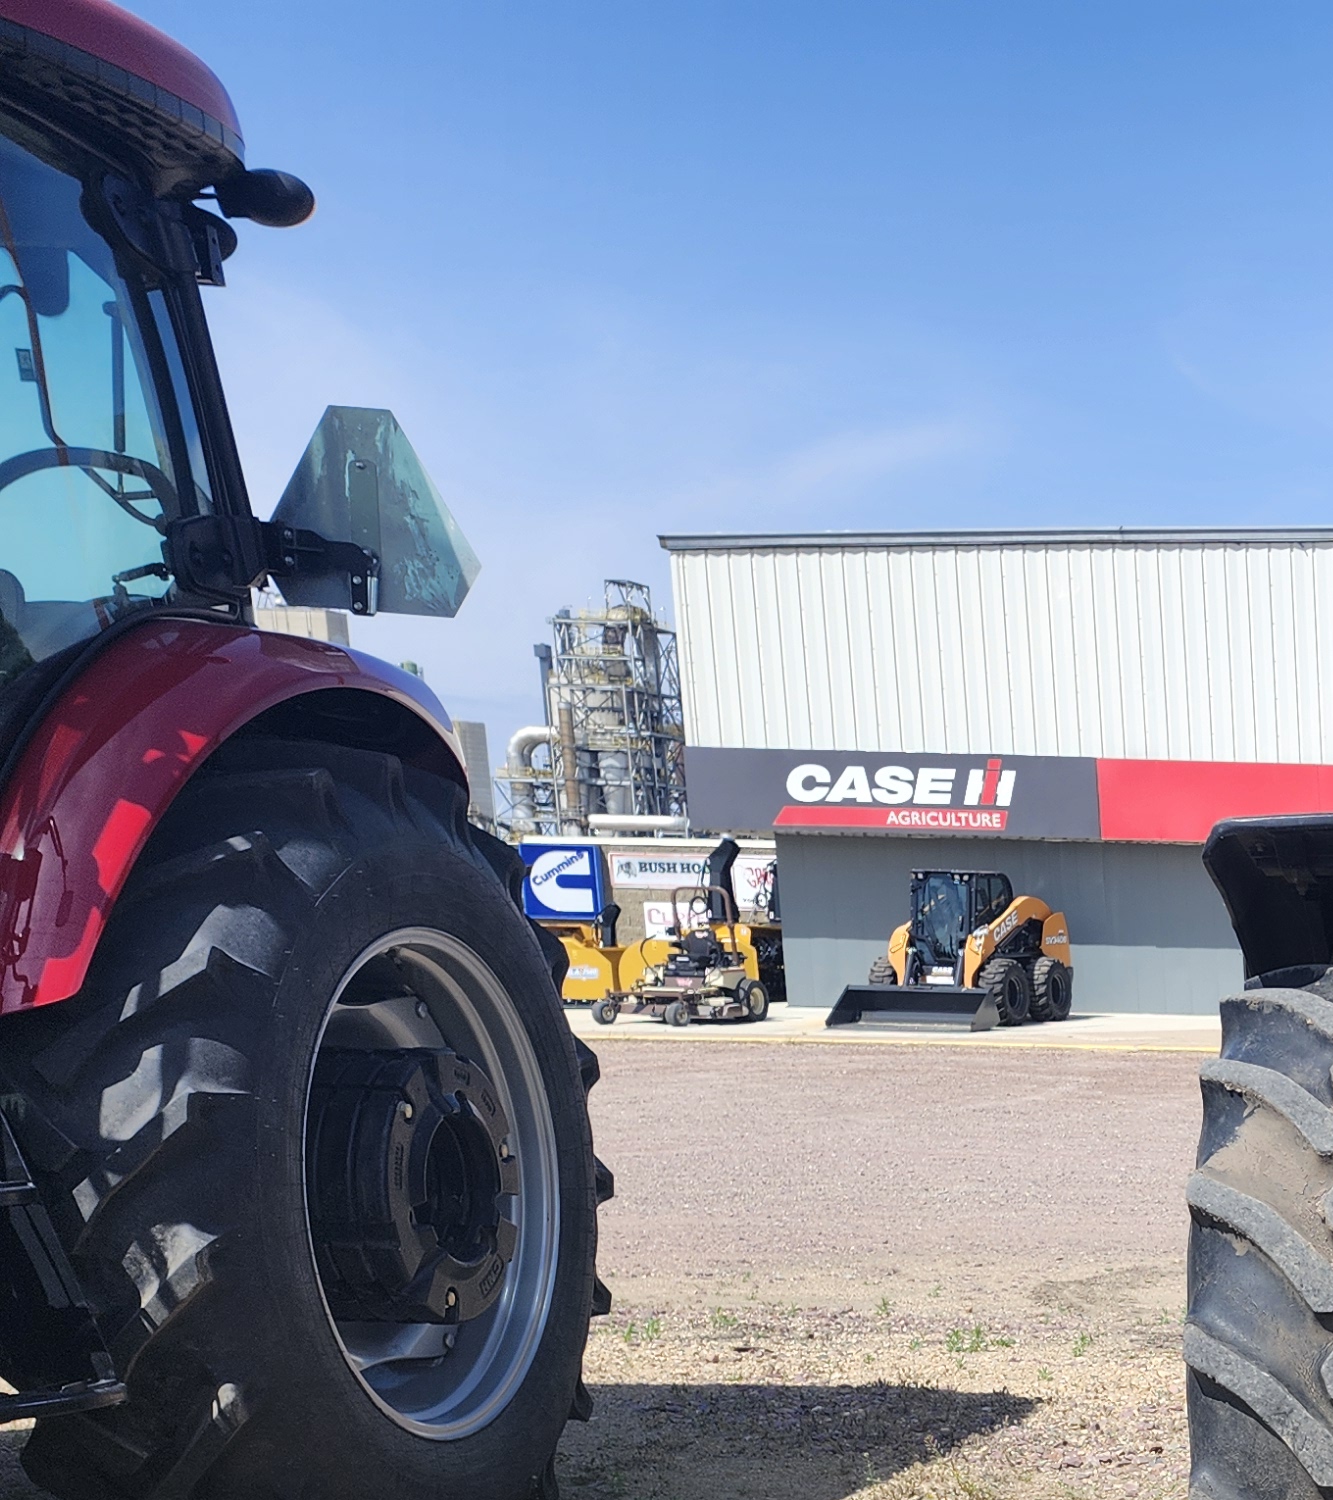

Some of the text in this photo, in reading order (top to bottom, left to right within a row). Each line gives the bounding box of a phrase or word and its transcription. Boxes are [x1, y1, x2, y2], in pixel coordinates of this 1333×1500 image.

[785, 763, 957, 805] CASE
[886, 811, 1002, 828] AGRICULTURE
[531, 848, 585, 887] Cummins
[638, 861, 677, 874] BUSH
[993, 909, 1019, 942] CASE
